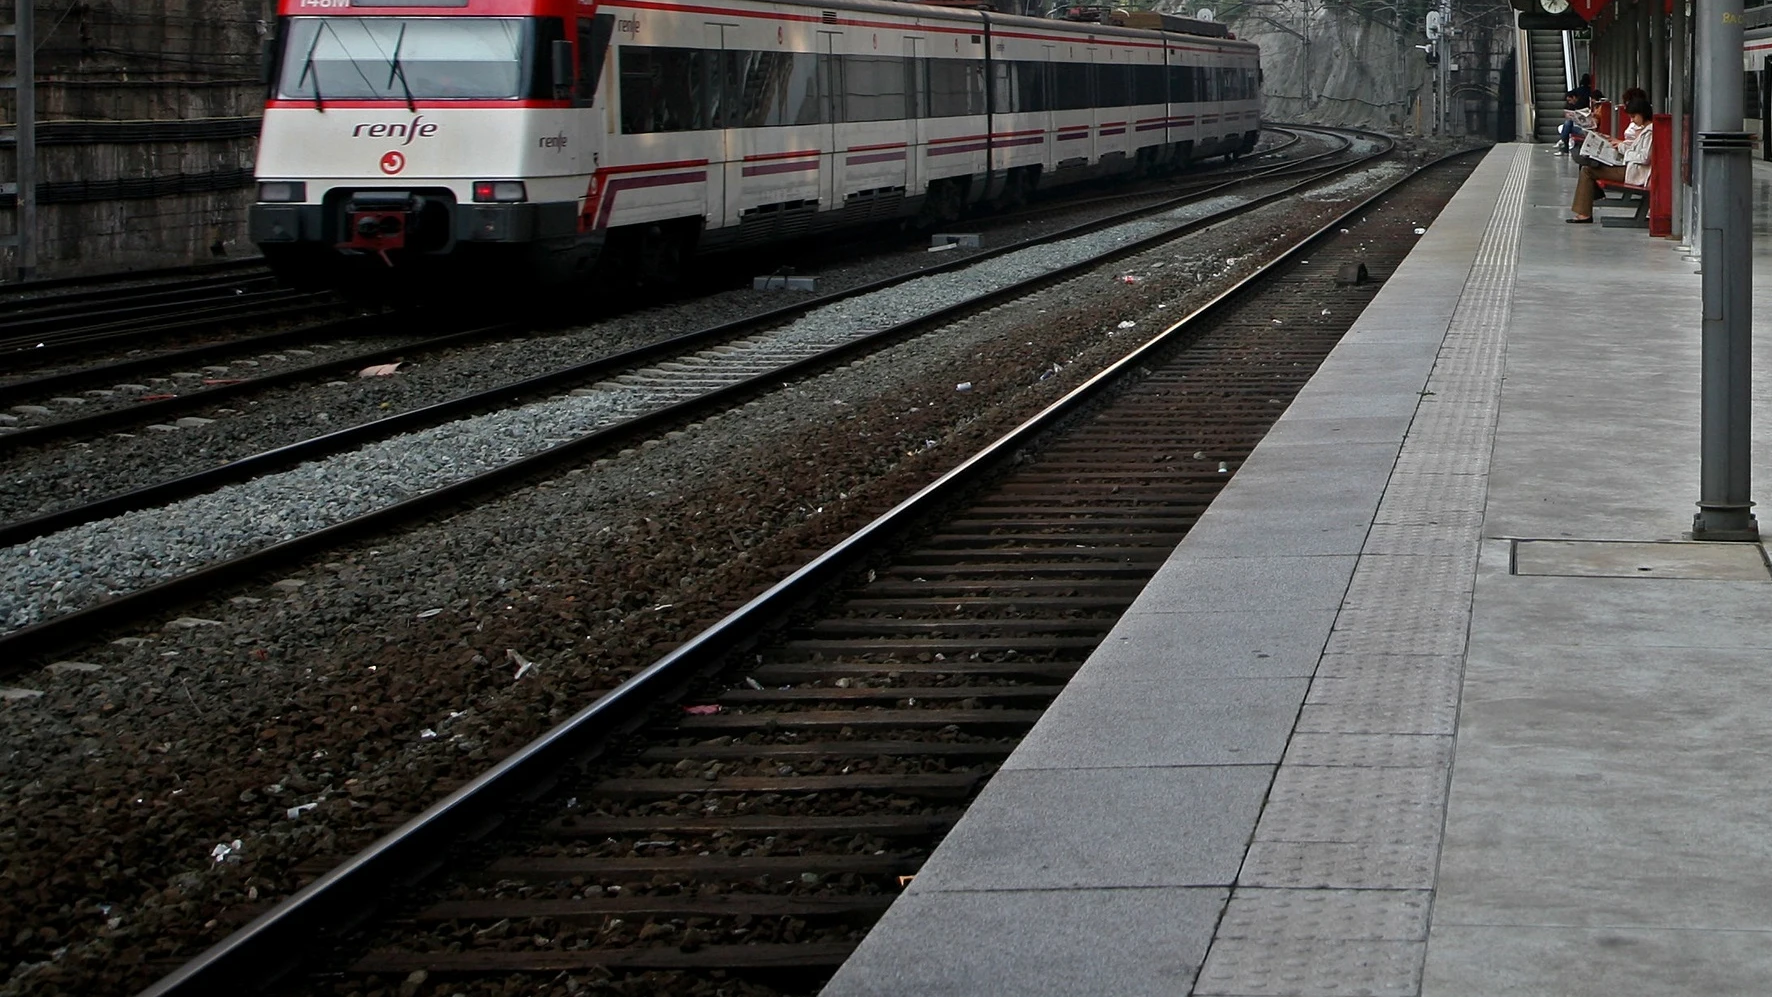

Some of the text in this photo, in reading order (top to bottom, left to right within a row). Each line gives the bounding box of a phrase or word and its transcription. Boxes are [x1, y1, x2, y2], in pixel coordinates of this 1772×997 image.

[618, 12, 641, 40] renfe
[352, 115, 438, 145] renfe
[539, 130, 567, 154] renfe
